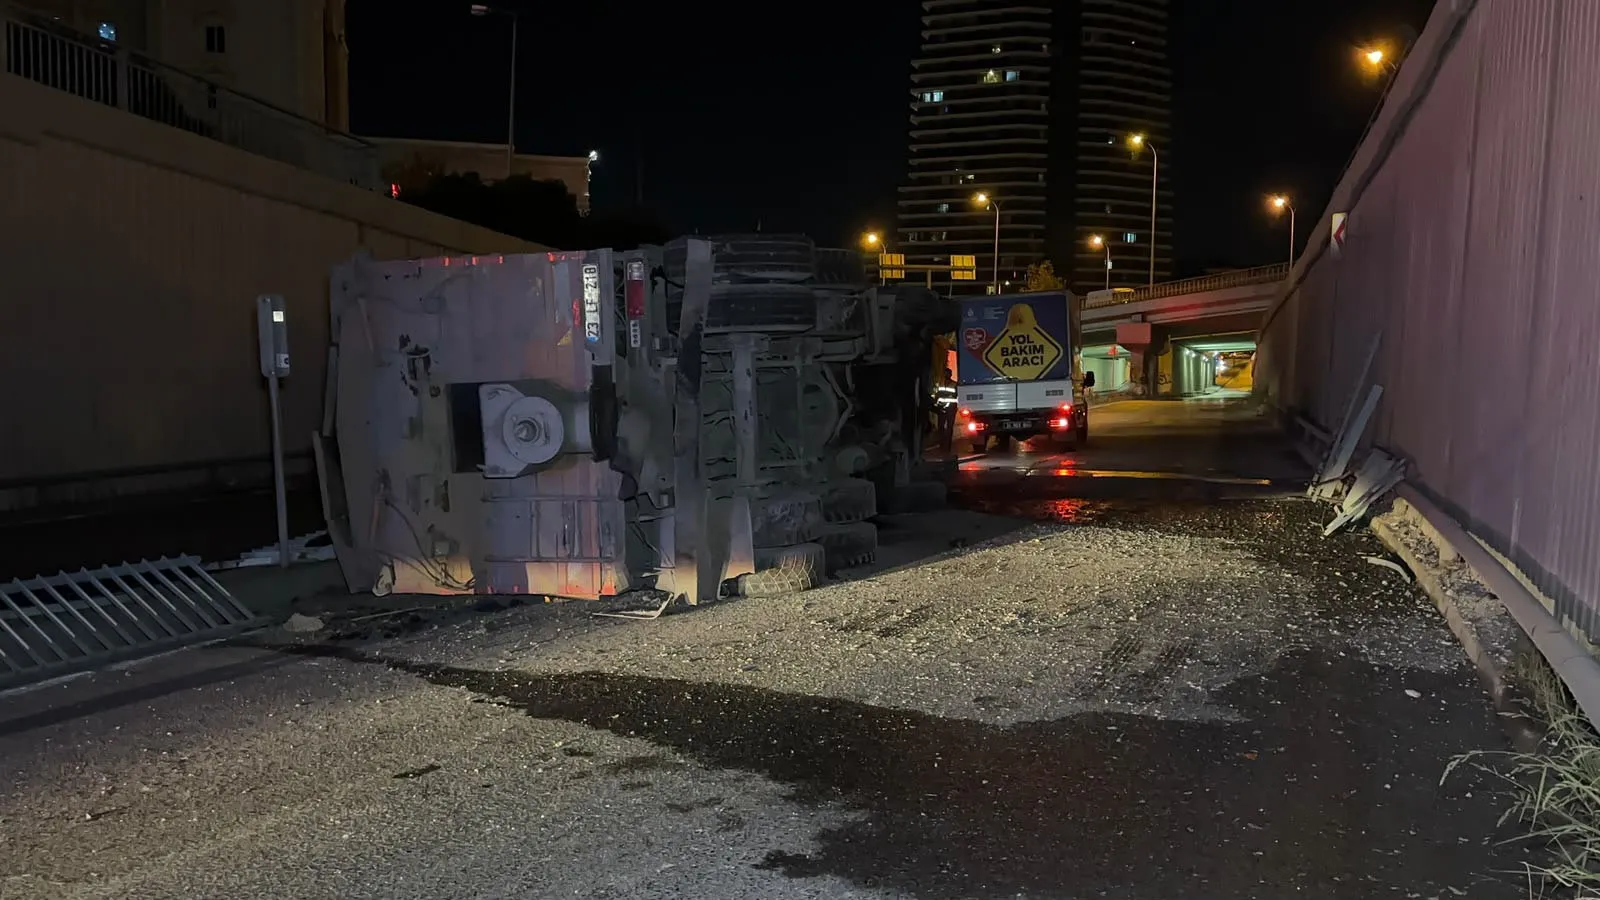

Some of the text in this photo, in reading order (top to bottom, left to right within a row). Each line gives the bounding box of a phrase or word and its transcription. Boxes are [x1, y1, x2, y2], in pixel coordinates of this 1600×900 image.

[587, 323, 599, 337] 23
[1009, 334, 1034, 345] YOL
[1001, 344, 1044, 357] BAKIM
[1002, 356, 1043, 368] ARACI
